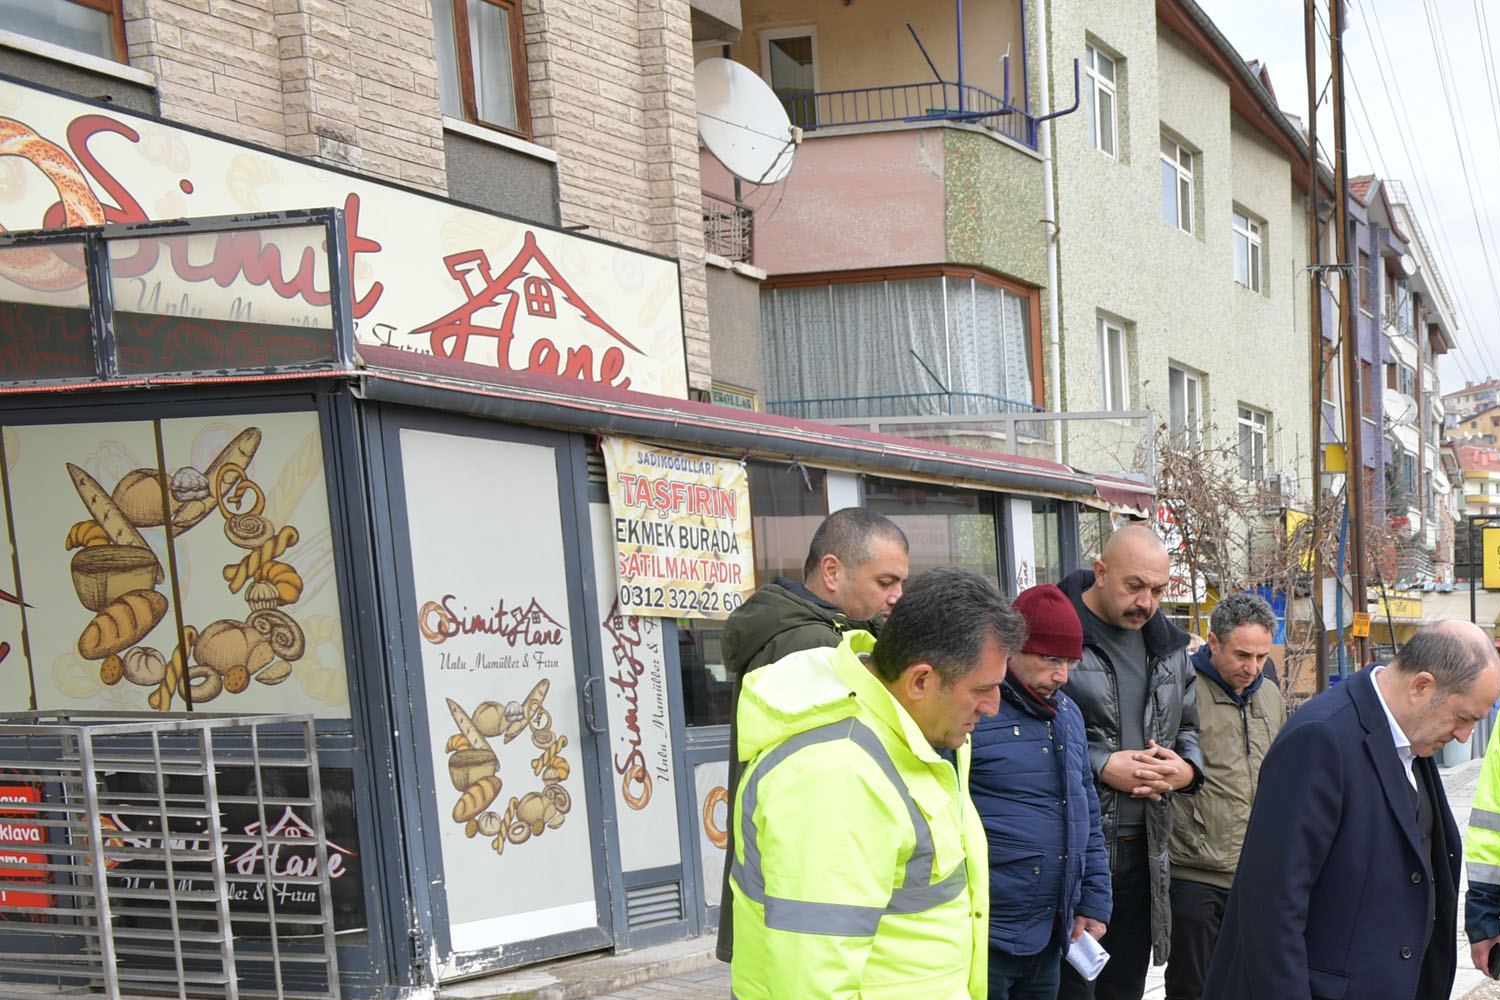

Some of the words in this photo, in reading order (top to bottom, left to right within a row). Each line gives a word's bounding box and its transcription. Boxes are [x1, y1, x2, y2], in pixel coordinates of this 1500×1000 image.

[43, 113, 384, 318] Simit
[637, 451, 715, 476] SADIKOĞULLARI
[618, 473, 738, 520] TAŞFIRIN
[615, 517, 675, 548] EKMEK
[679, 525, 740, 555] BURADA
[618, 552, 742, 584] SATILMAKTADIR
[620, 585, 665, 608] 0312
[668, 588, 698, 610] 322
[701, 591, 720, 611] 22
[438, 594, 508, 638] Simit
[507, 598, 566, 647] Hane
[609, 664, 647, 784] Simit
